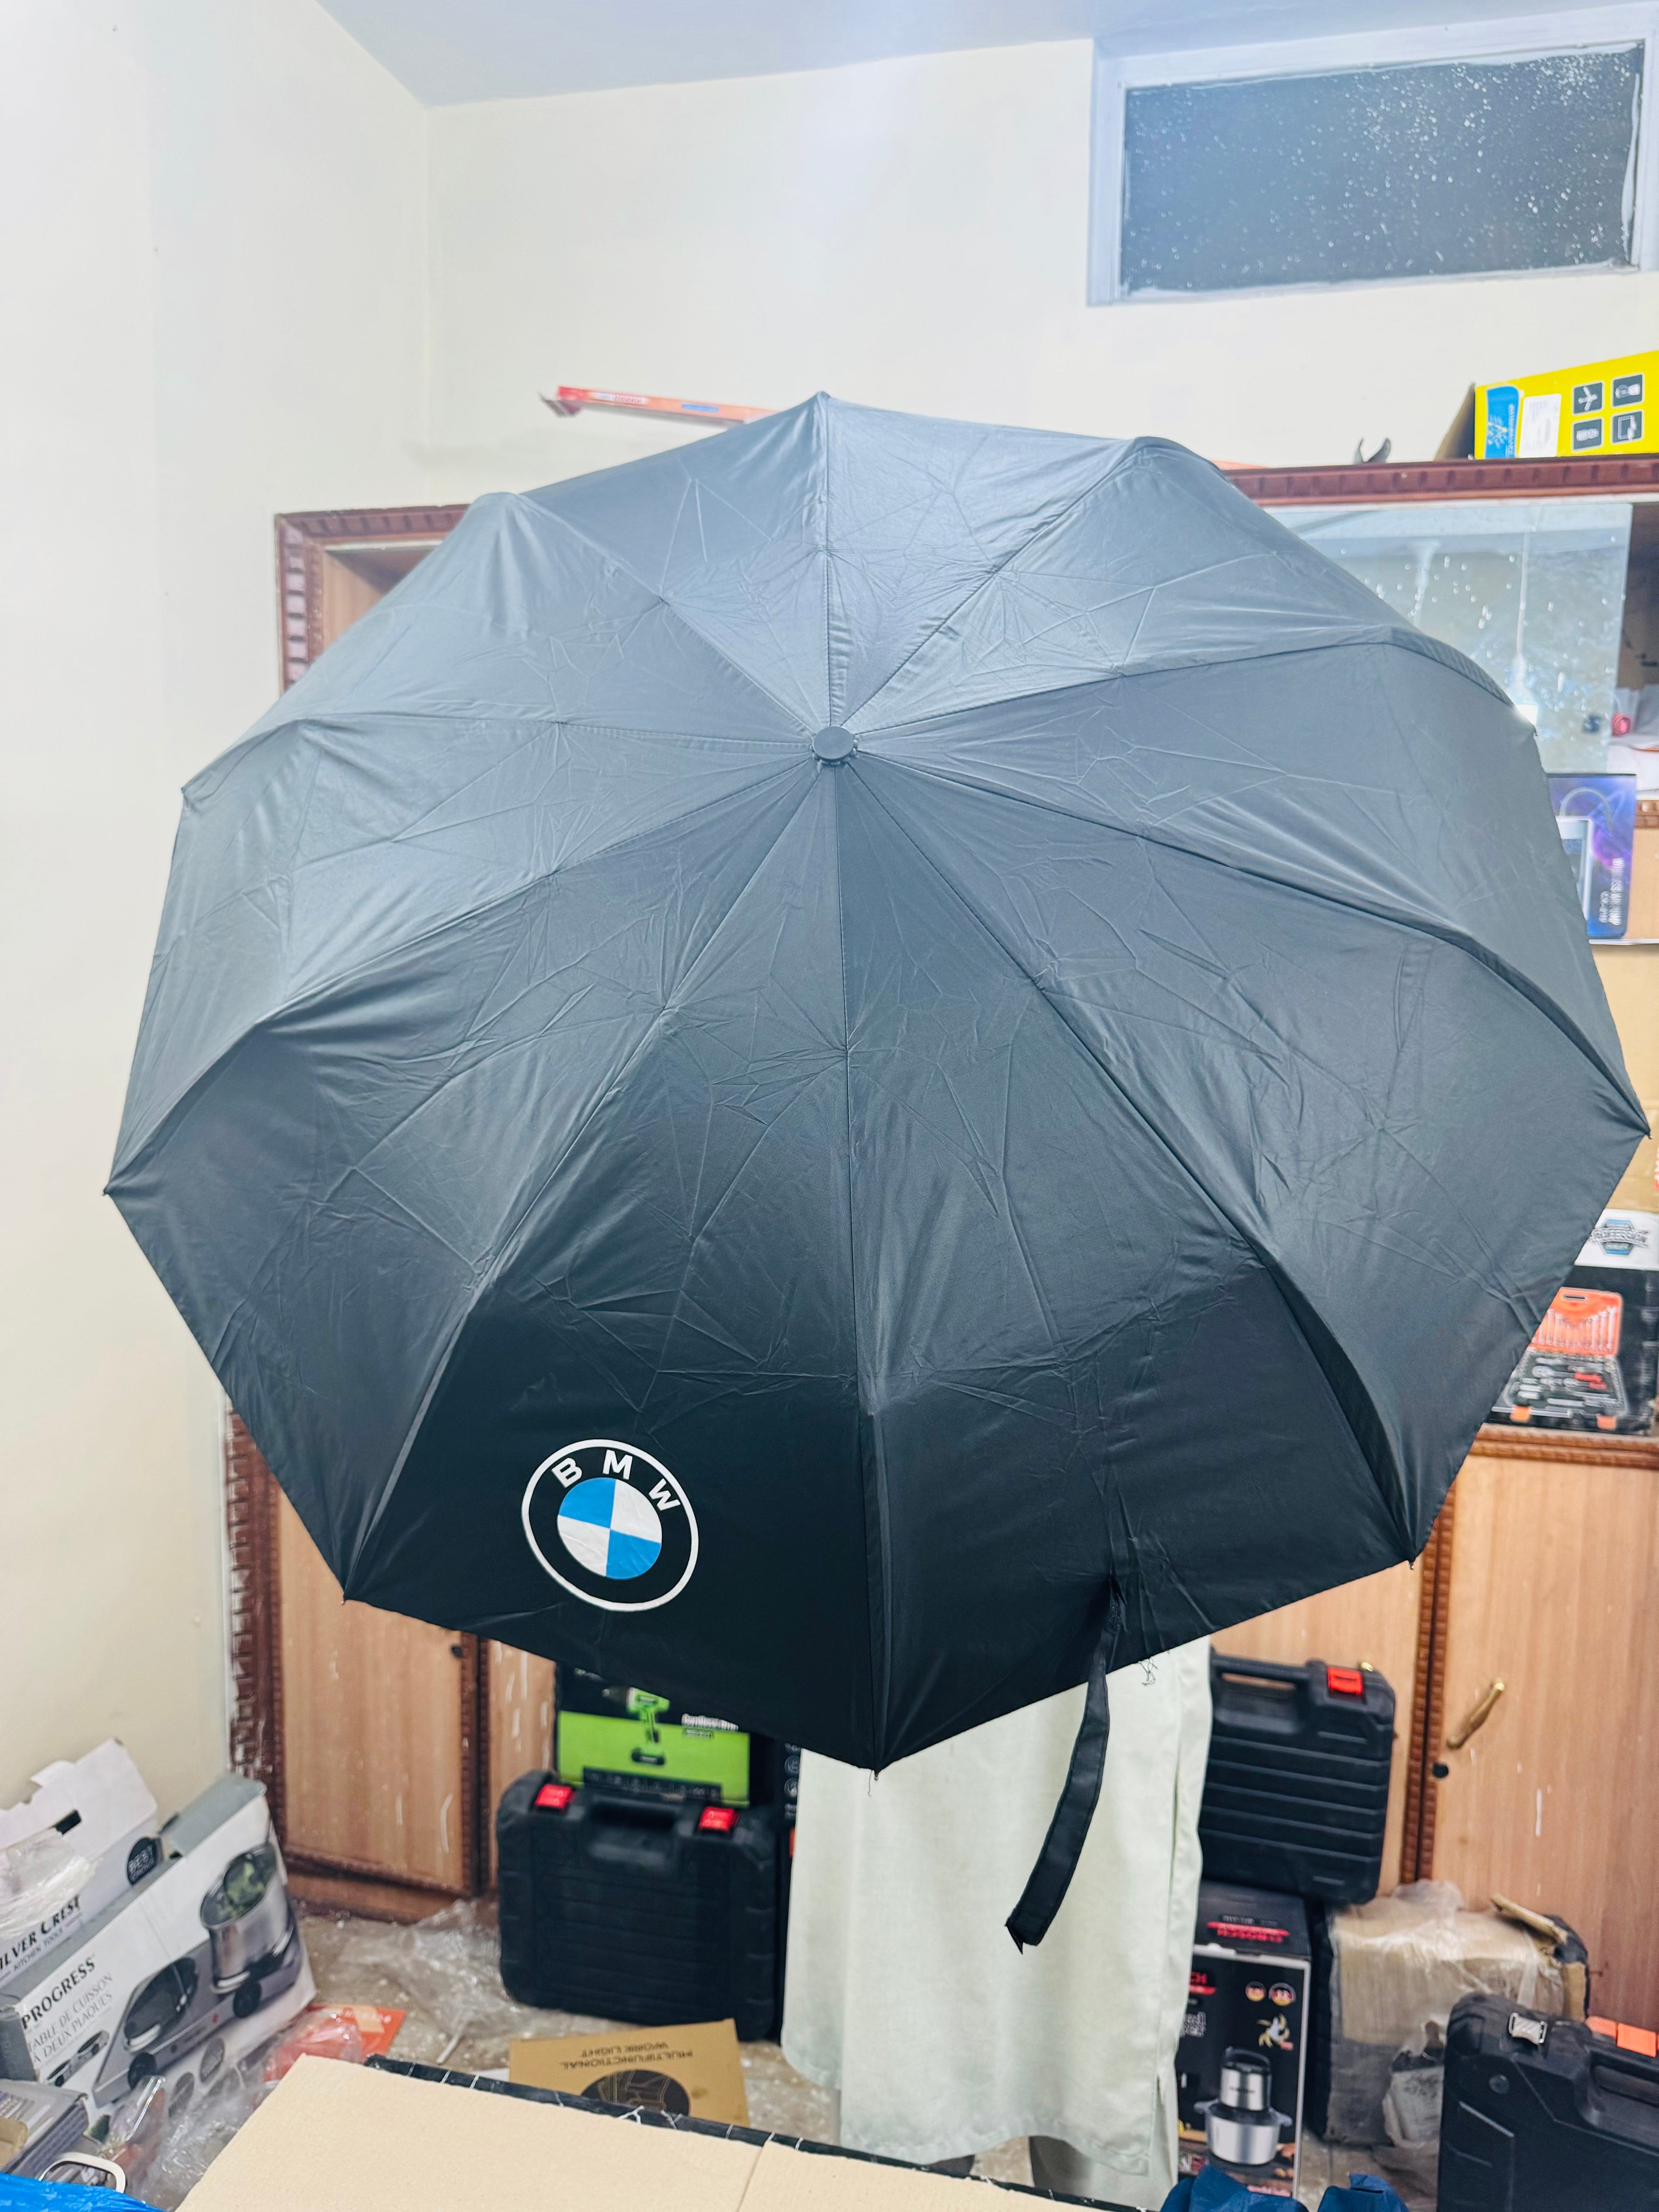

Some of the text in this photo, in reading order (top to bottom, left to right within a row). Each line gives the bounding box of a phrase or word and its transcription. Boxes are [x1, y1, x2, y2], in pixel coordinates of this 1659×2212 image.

[551, 1449, 681, 1511] BMW
[0, 1894, 81, 1970] ILVER CREST
[22, 1957, 95, 2029] PROGRESS
[28, 2024, 57, 2052] TABLE
[59, 2011, 73, 2028] DE
[73, 1972, 113, 2013] CUISSON
[43, 2030, 72, 2057] DEUX
[71, 1993, 113, 2032] PLAQUES
[561, 2050, 693, 2069] MULTIFUNCTIONAL
[582, 2041, 669, 2057] WORK LIGHT
